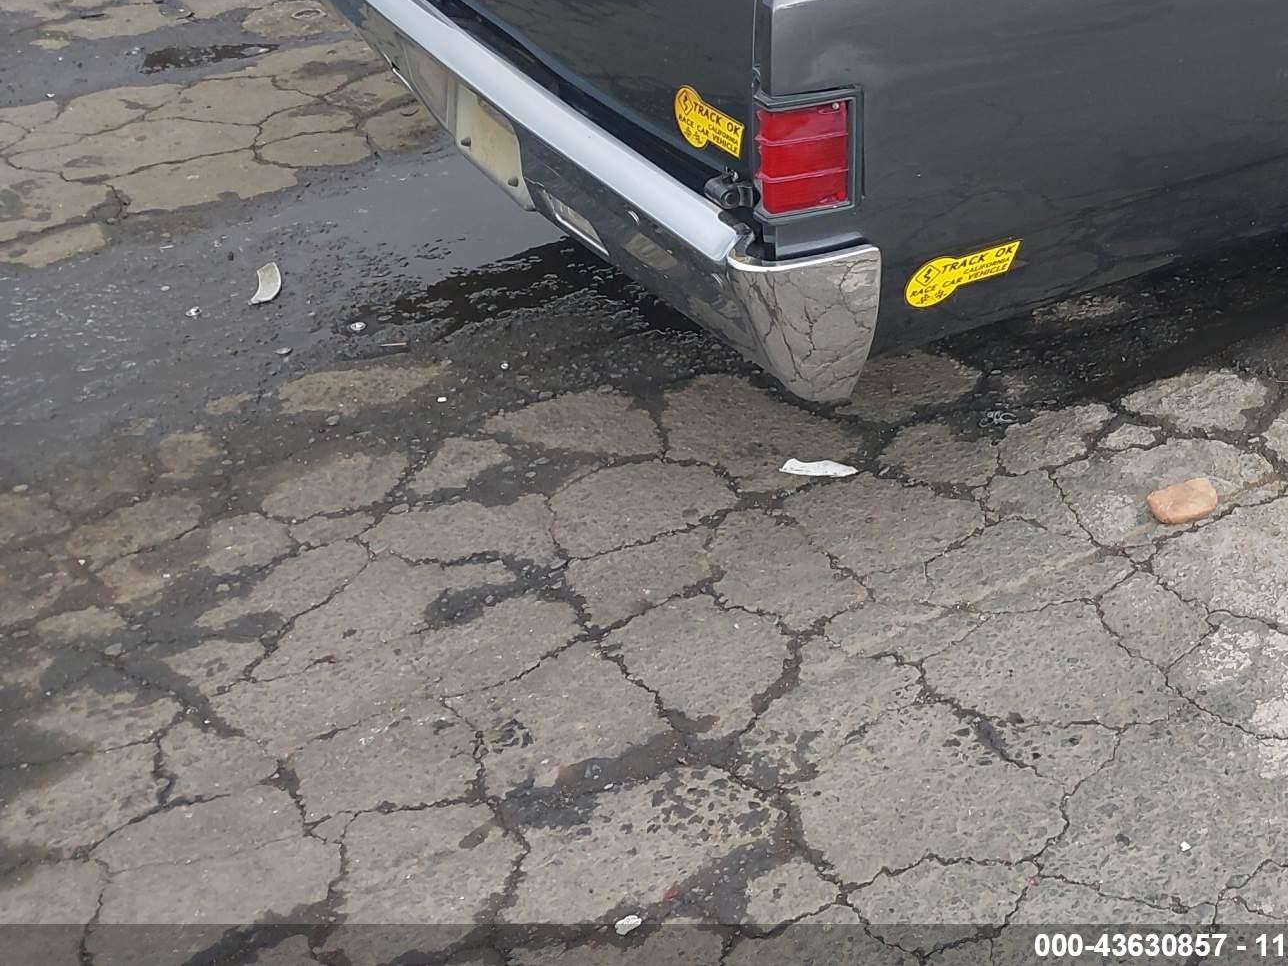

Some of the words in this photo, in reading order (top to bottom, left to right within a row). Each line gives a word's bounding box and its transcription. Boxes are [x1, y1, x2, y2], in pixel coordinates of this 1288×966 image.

[678, 113, 695, 129] RACE
[696, 124, 710, 137] CAR
[712, 133, 739, 155] VEHICLE
[693, 101, 722, 127] TRACK
[726, 121, 741, 137] OK
[708, 123, 739, 146] CALIFORNIA
[941, 252, 988, 274] TRACK
[995, 244, 1017, 258] OK
[962, 257, 1010, 275] CALIFORNIA
[909, 284, 937, 298] RACE
[942, 276, 963, 288] CAR
[967, 263, 1008, 281] VEHICLE
